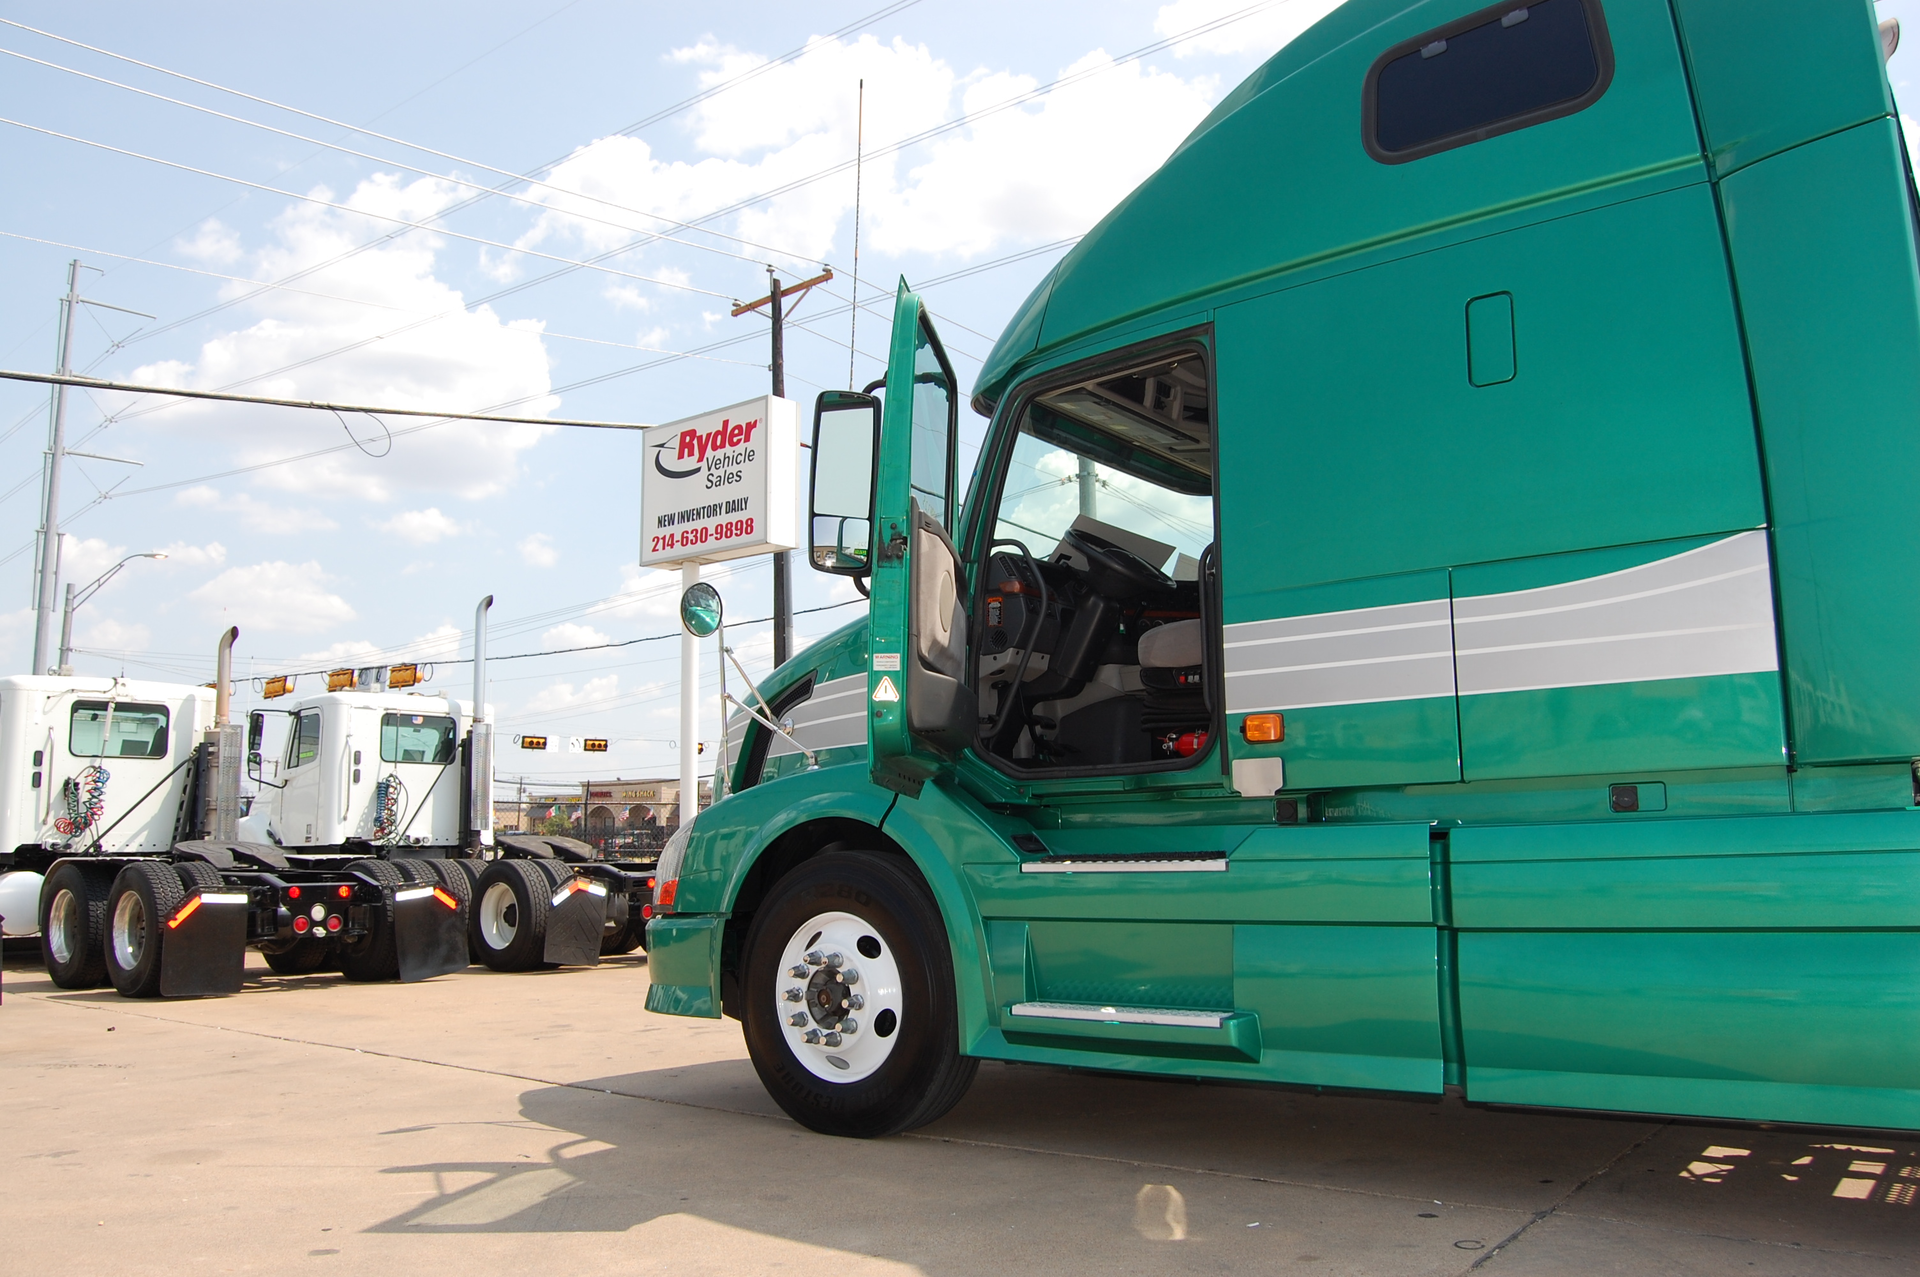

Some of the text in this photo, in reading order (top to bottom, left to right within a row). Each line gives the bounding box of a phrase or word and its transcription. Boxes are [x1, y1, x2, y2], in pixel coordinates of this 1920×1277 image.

[677, 418, 758, 463] Ryder
[705, 447, 755, 472] Vehicle
[705, 470, 742, 490] Sales
[657, 496, 749, 529] NEW INVENTORY DAILY
[651, 517, 755, 552] 214-630-9898
